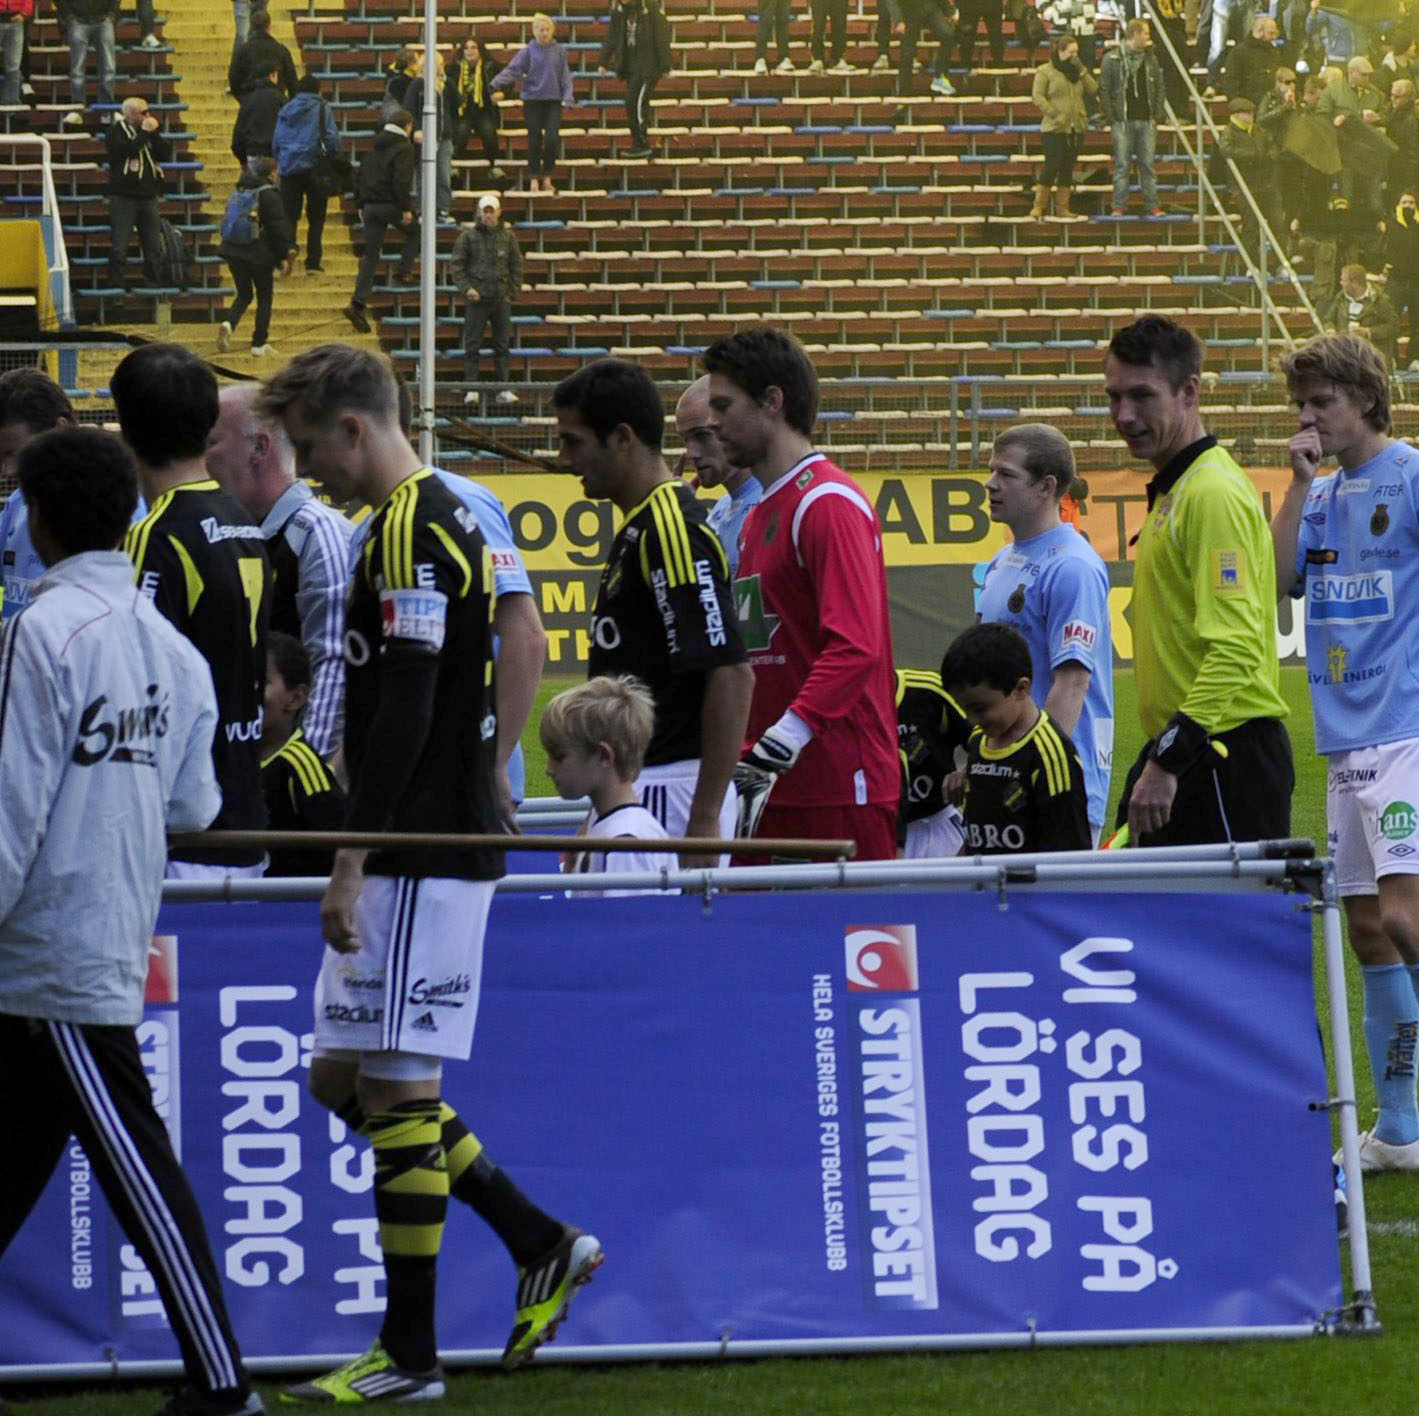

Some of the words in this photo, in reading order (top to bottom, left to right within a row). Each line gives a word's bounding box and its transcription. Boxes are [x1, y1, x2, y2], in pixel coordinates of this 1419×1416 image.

[694, 559, 727, 647] stadium
[1063, 624, 1095, 645] MAXI
[968, 763, 1013, 778] stadium
[967, 823, 1026, 850] BRO
[811, 973, 833, 1022] HELA
[1059, 936, 1138, 1005] VI
[815, 1026, 840, 1119] SVERIGES
[958, 971, 1057, 1263] LÖRDAG
[1065, 1027, 1150, 1173] SES
[218, 985, 318, 1287] LÖRDAG
[857, 1007, 928, 1303] STRYKTIPSET
[819, 1120, 849, 1273] FOTBOLLSKLUBB
[1076, 1194, 1180, 1293] PÅ
